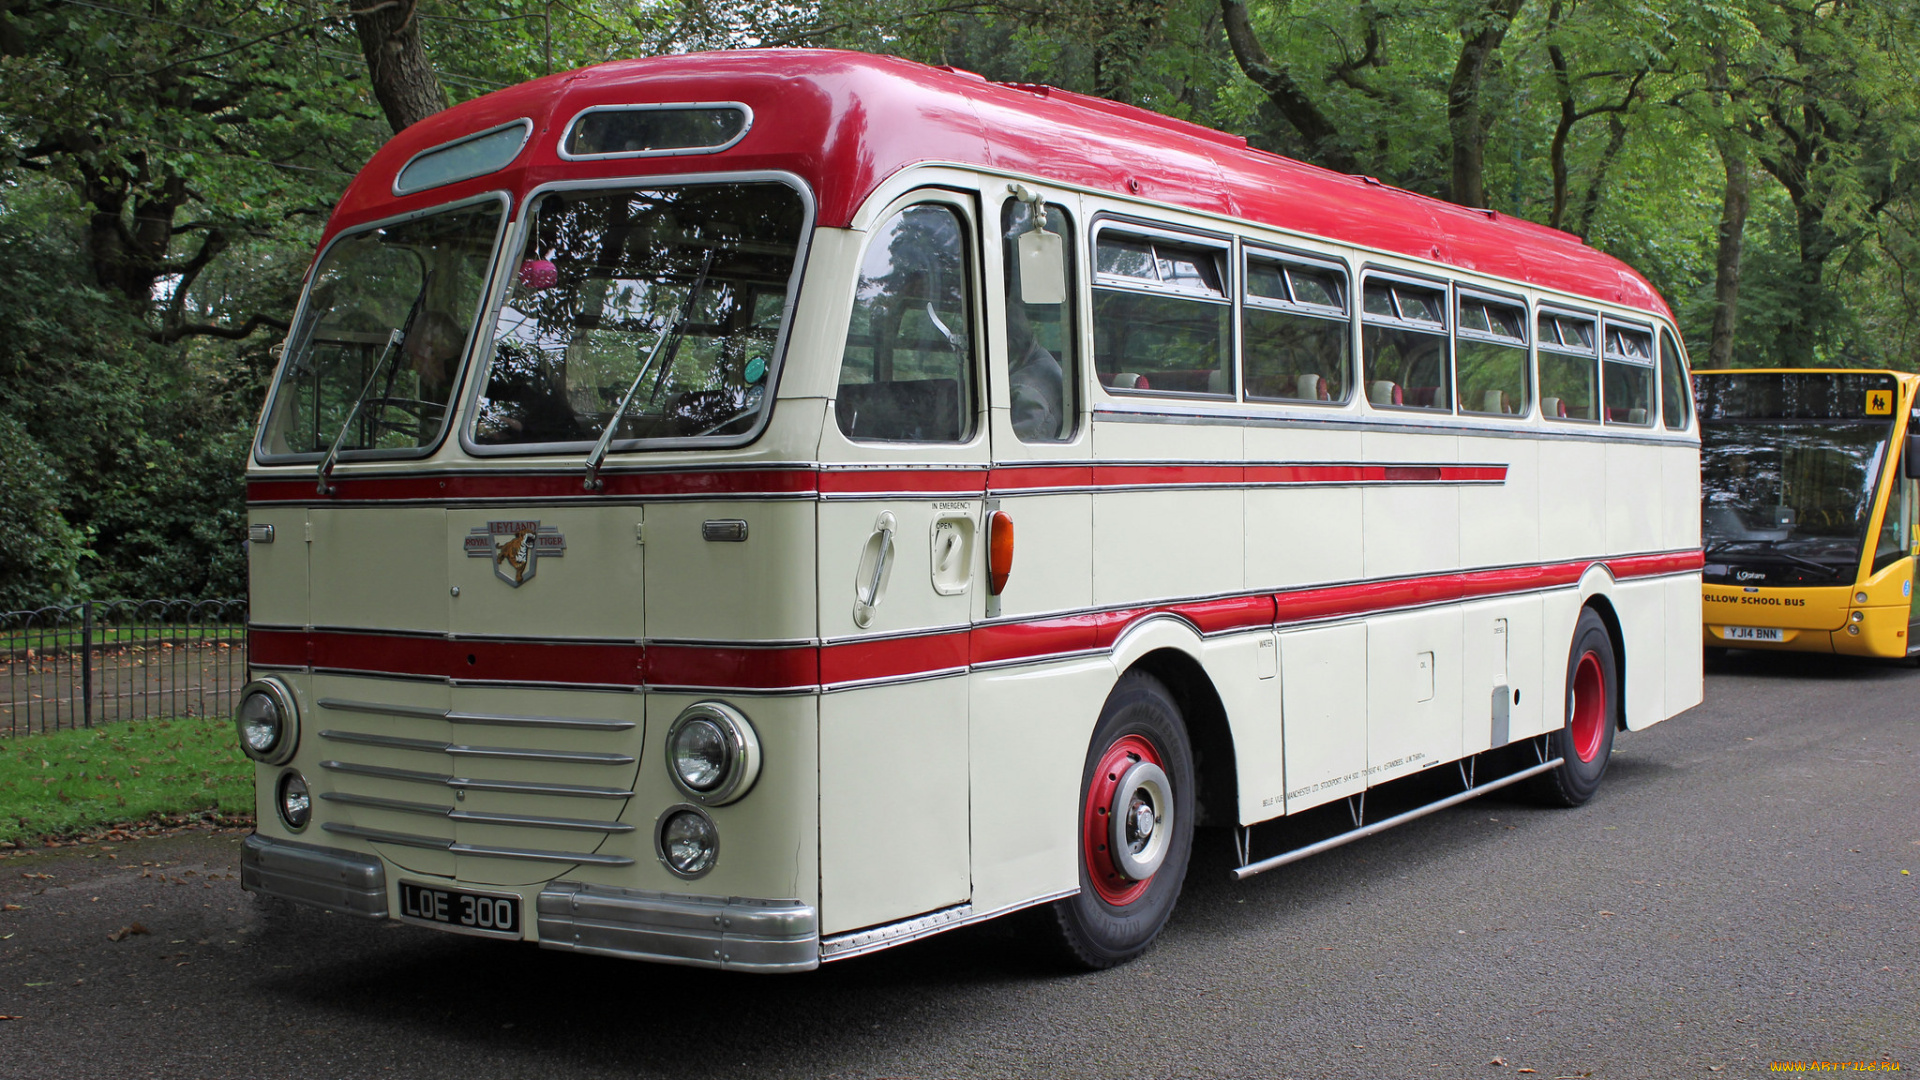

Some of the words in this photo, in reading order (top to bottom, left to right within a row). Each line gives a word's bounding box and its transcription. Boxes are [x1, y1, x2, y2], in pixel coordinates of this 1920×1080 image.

[490, 521, 537, 534] LEYLAND
[465, 538, 489, 546] ROYAL
[539, 537, 563, 546] TIGER
[1741, 596, 1781, 605] SCHOOL
[1784, 598, 1805, 606] BUS
[1731, 627, 1753, 638] YJ14
[1756, 628, 1777, 639] BNN
[406, 886, 449, 921] LOE
[460, 895, 512, 929] 300
